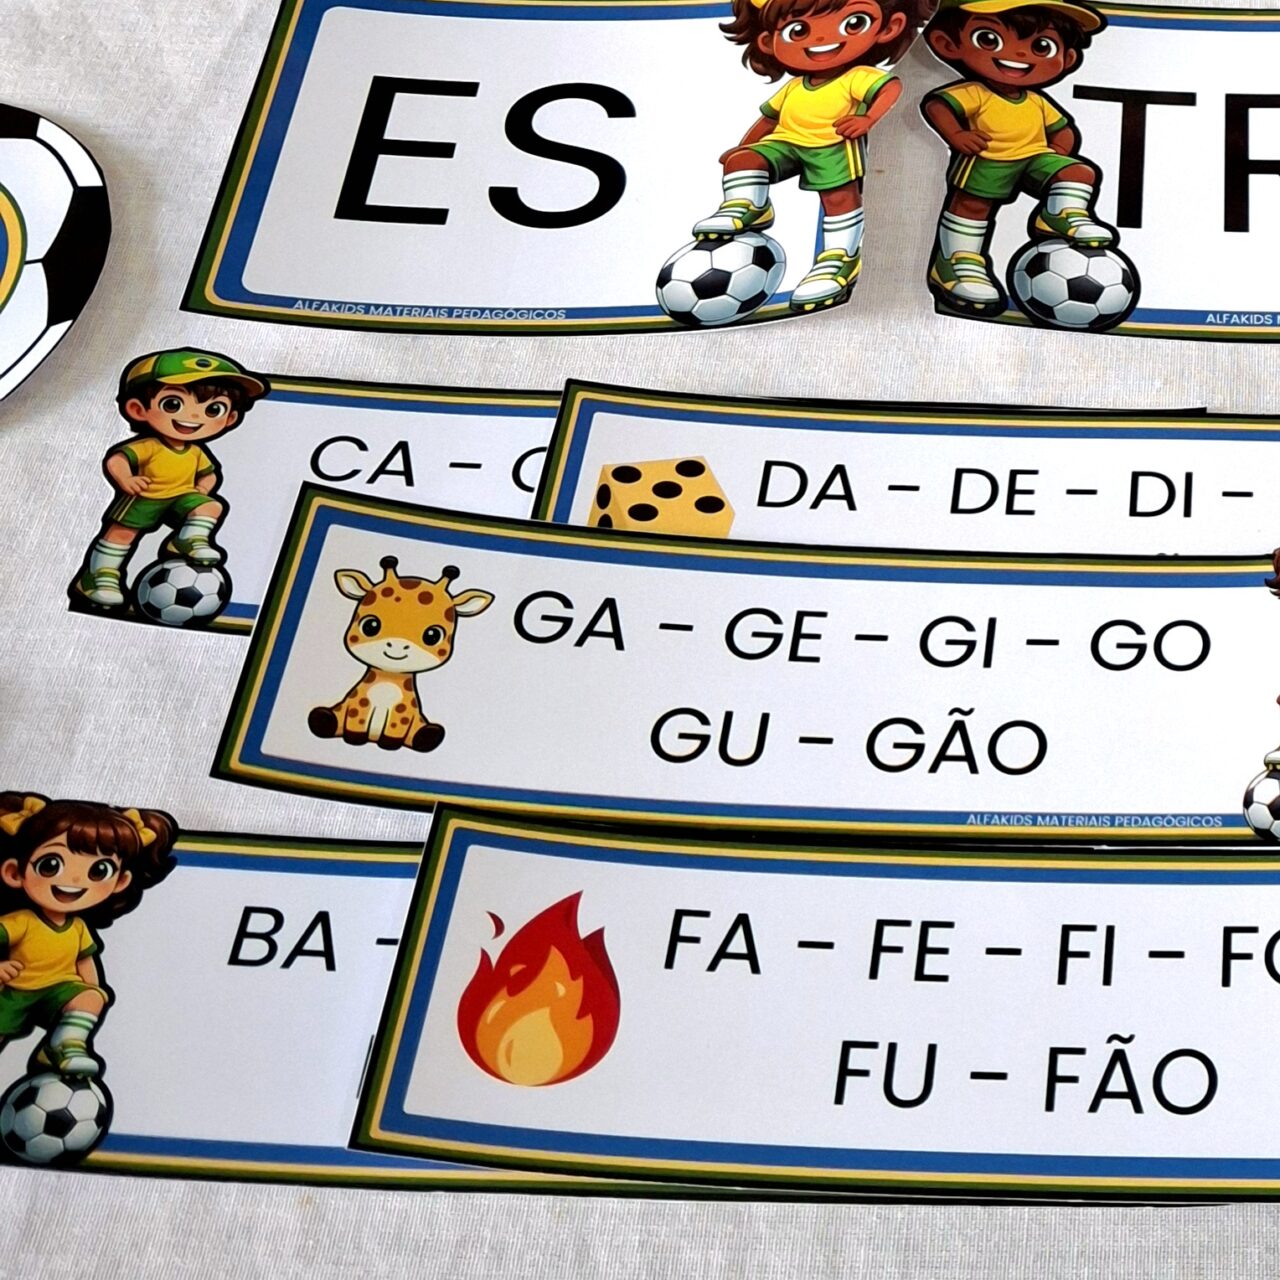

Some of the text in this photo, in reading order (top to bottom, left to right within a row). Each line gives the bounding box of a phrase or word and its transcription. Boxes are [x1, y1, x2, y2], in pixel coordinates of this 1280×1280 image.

[333, 75, 636, 229] ES
[293, 299, 566, 320] ALFAKIDS MATERIAIS PEDAGÓGICOS
[1206, 313, 1273, 325] ALFAKIDS
[310, 436, 414, 486] CA
[757, 461, 856, 510] DA
[951, 468, 1038, 515] DE
[1129, 471, 1192, 517] DI
[514, 591, 624, 650] GA
[725, 608, 827, 662] GE
[920, 616, 996, 668] GI
[1091, 620, 1210, 671] GO
[651, 708, 769, 766] GU
[867, 708, 1047, 775] GÃO
[967, 813, 1222, 827] ALFAKIDS MATERIAIS PEDAGÓGICOS
[228, 906, 335, 971] BA
[665, 909, 760, 974] FA
[869, 919, 954, 982] FE
[1058, 925, 1114, 986] FI
[834, 1041, 937, 1108] FU
[1045, 1034, 1217, 1115] FÃO
